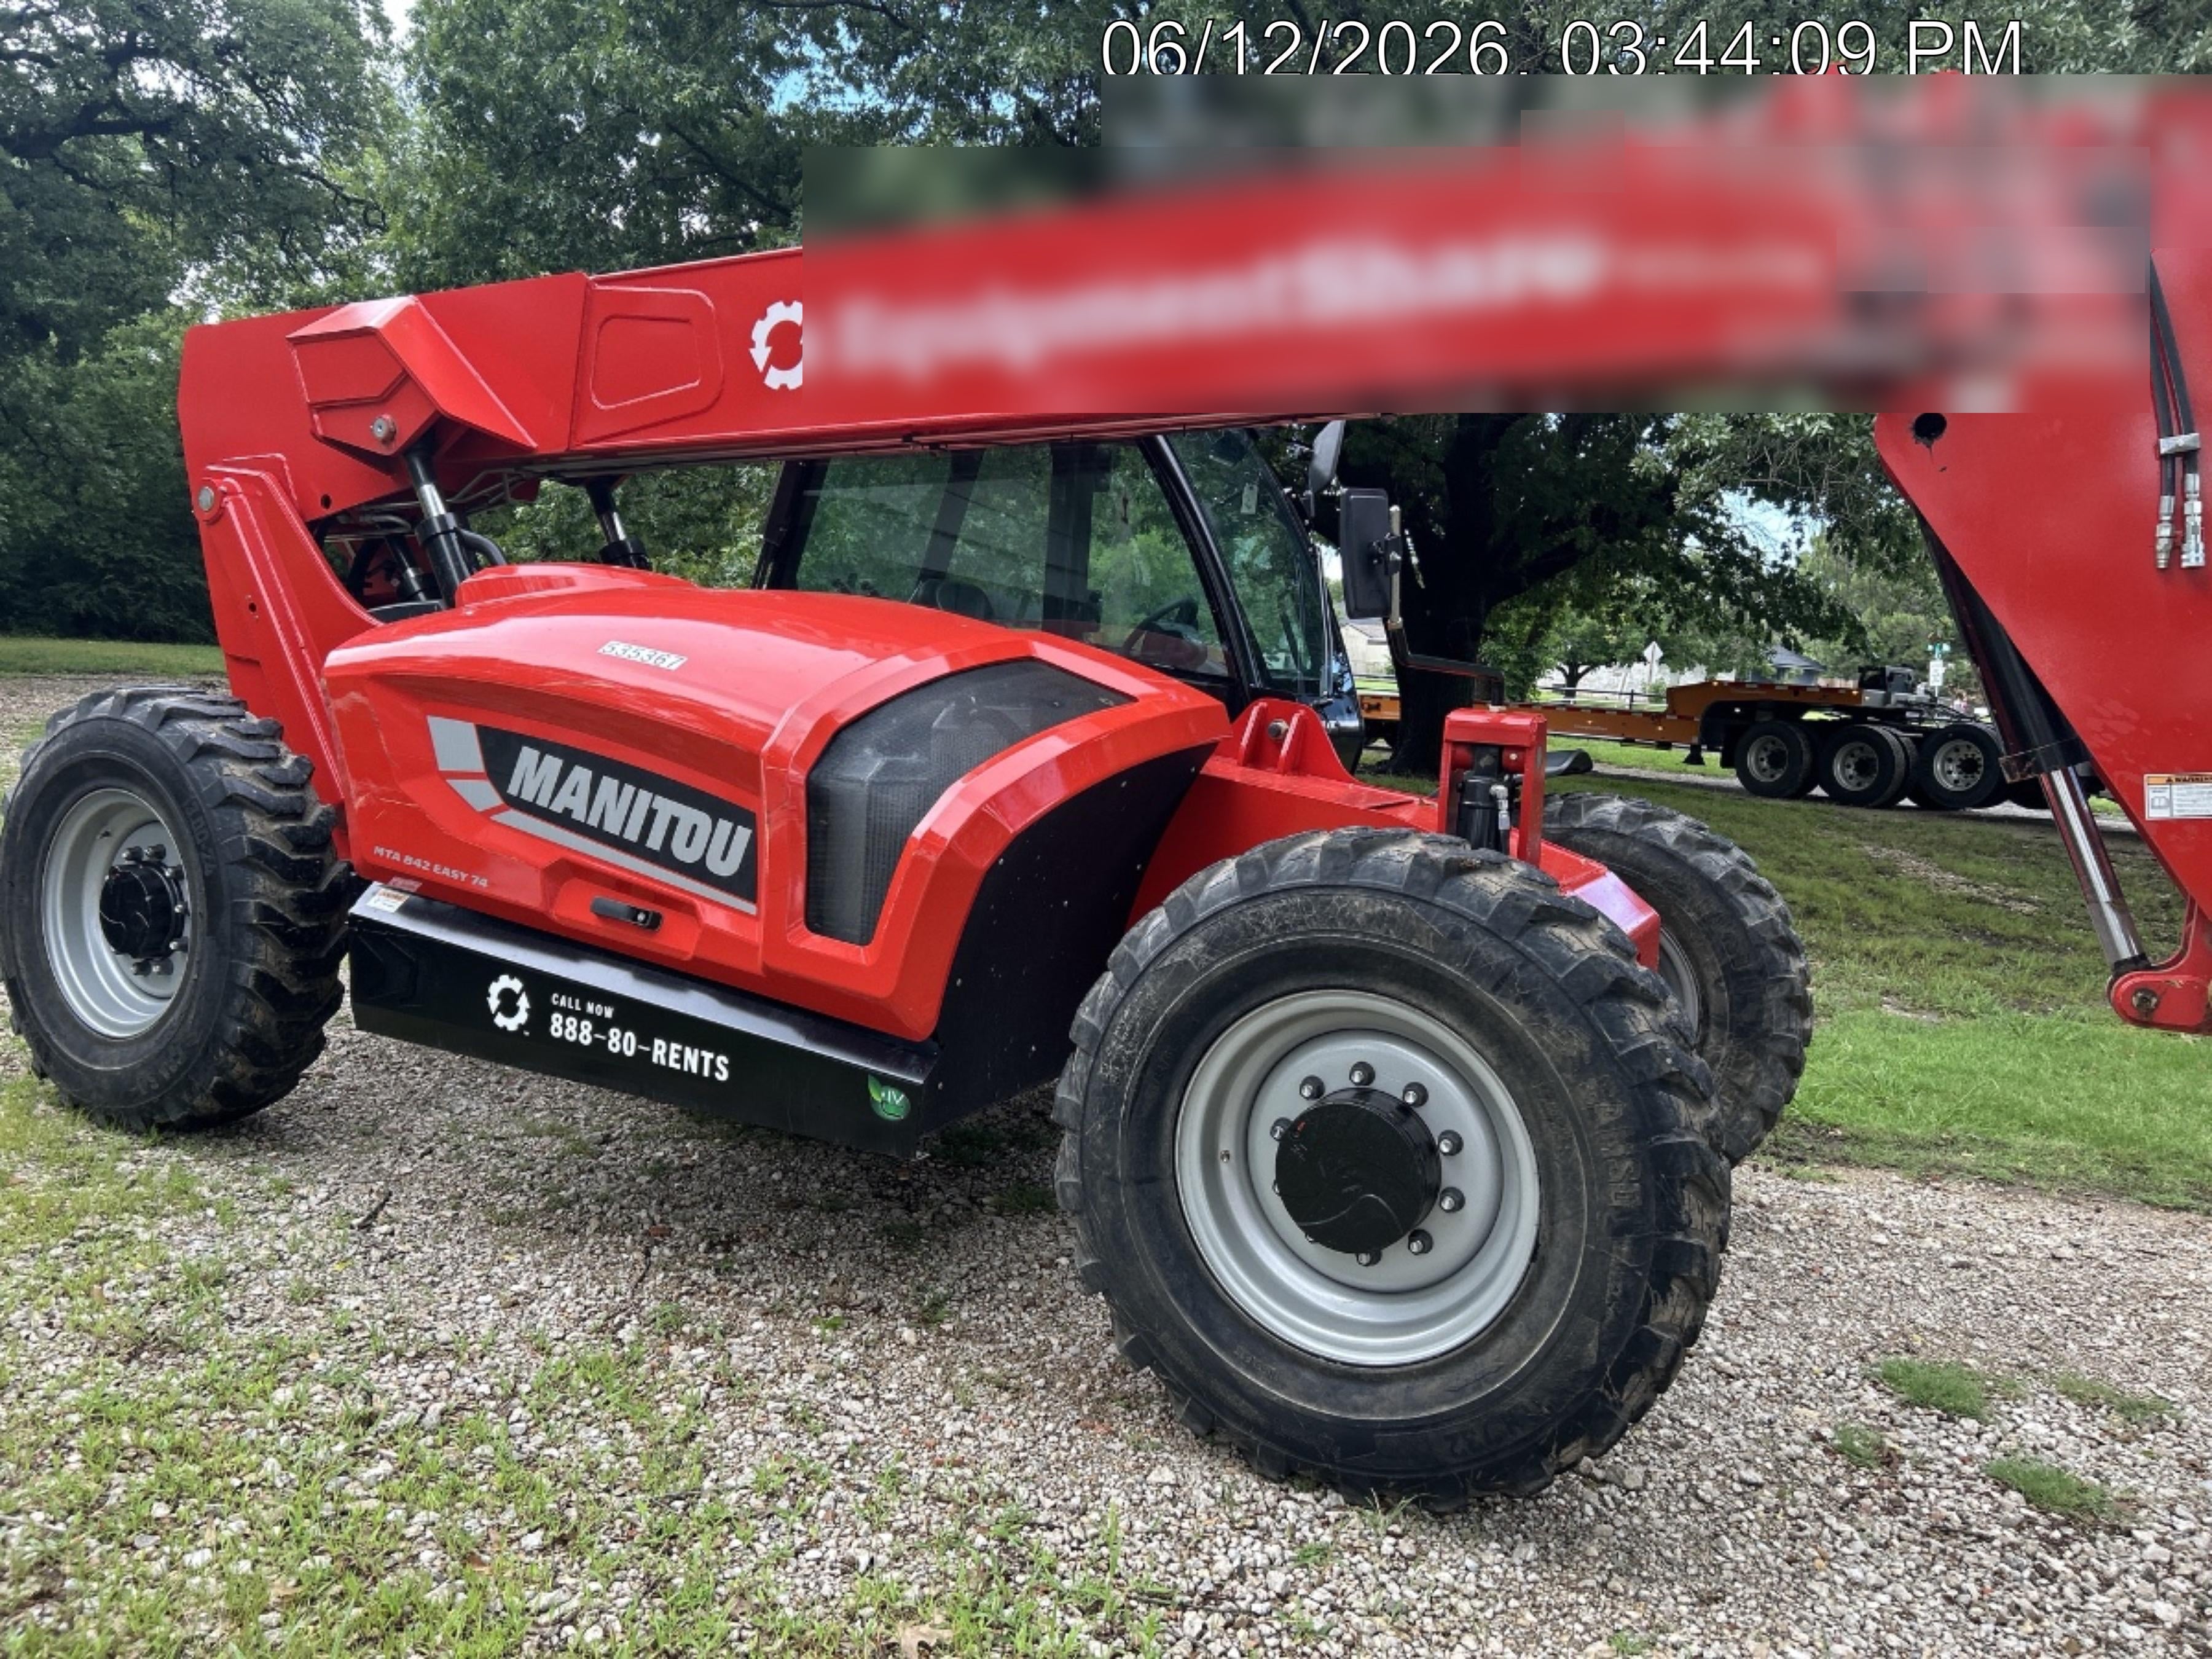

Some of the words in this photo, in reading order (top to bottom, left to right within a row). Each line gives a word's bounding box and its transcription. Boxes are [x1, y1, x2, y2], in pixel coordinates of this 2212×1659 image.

[507, 745, 752, 877] MANITOU
[373, 845, 401, 862] MTA
[403, 855, 430, 871] 842
[433, 864, 469, 882] EASY
[471, 874, 489, 888] 74
[551, 993, 582, 1011] CALL
[586, 1001, 614, 1018] NOW
[550, 1013, 730, 1081] 888-80-RENTS
